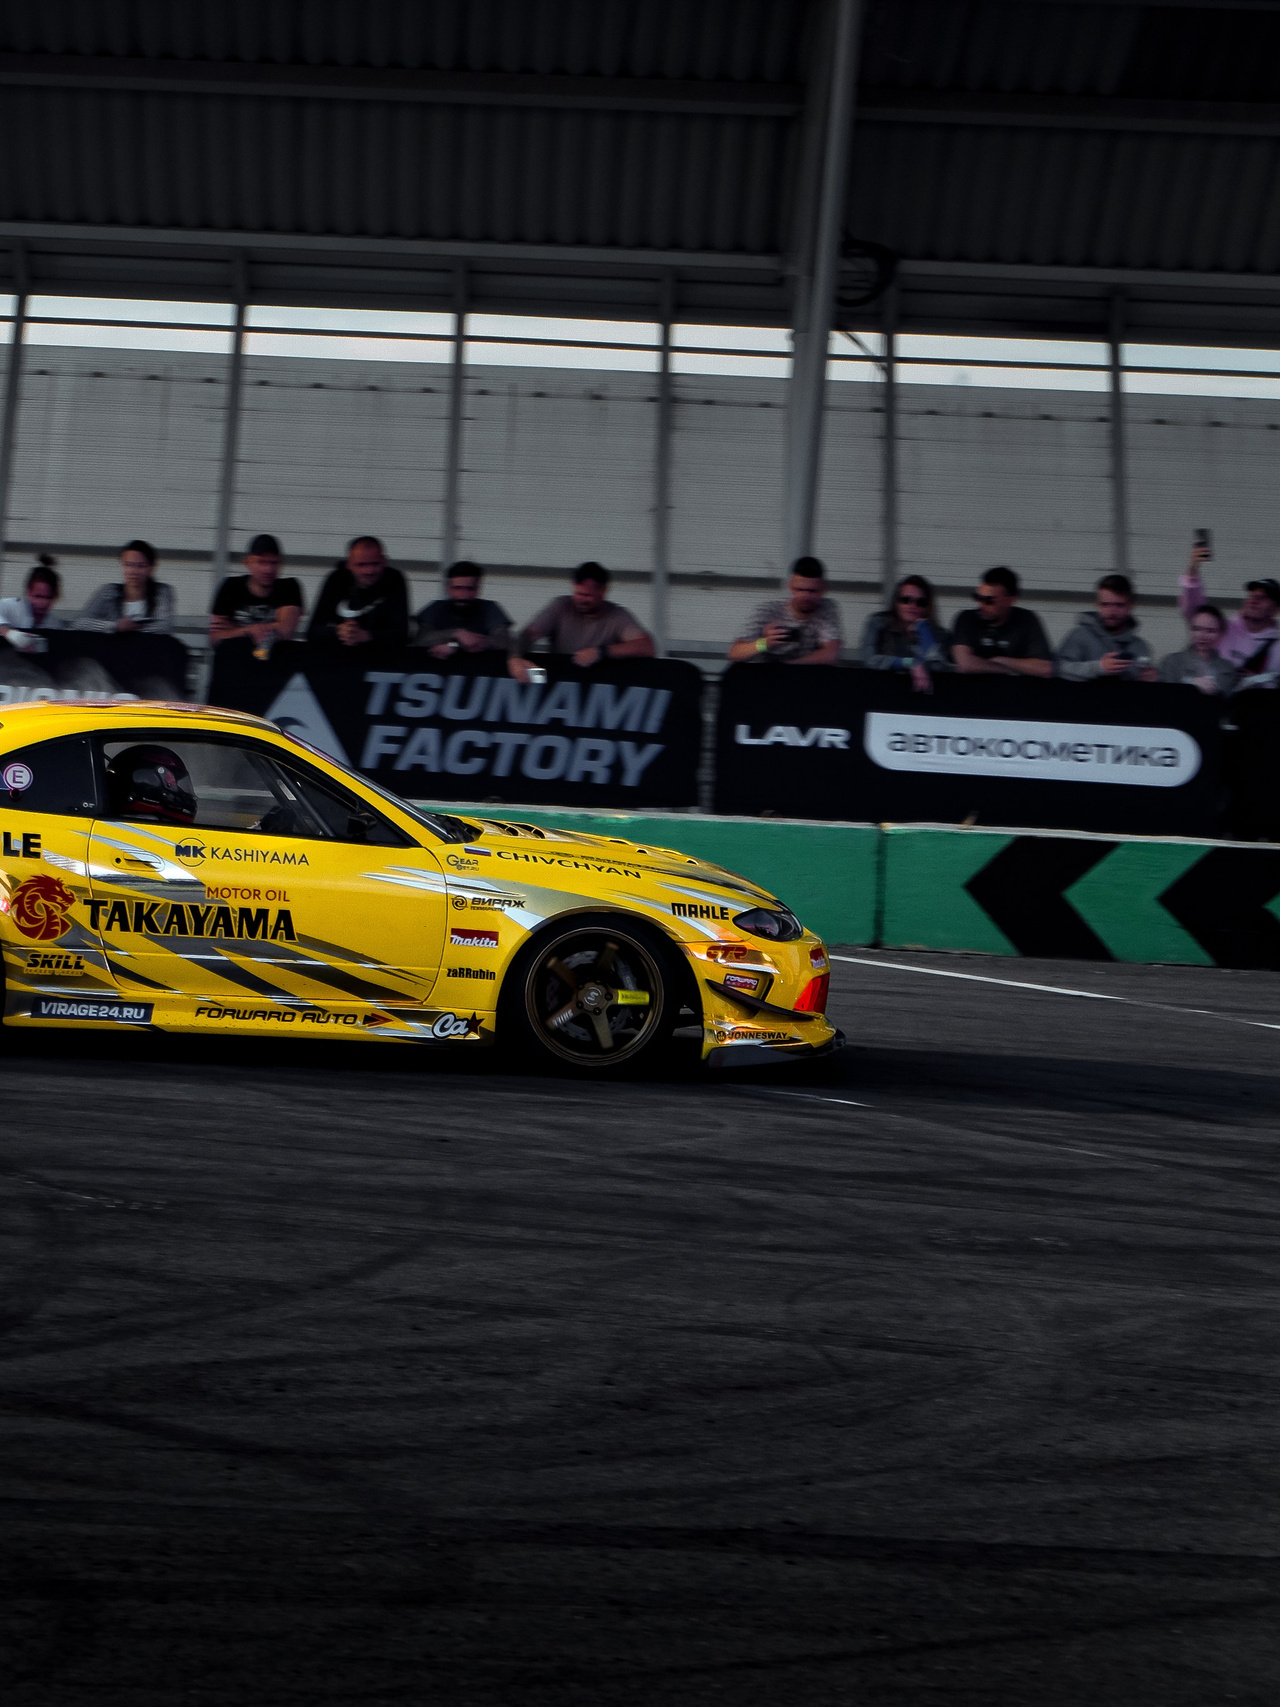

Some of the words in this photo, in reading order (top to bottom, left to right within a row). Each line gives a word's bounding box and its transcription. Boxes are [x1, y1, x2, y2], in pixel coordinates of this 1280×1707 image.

[364, 671, 672, 734] TSUNAMI
[734, 724, 851, 750] LAVR
[361, 724, 666, 787] FACTORY
[886, 730, 1182, 768] автокосметика
[12, 770, 24, 784] E
[175, 844, 207, 859] MK
[210, 847, 310, 866] KASHIYAMA
[496, 851, 642, 879] CHIVCHYAN
[206, 886, 263, 901] MOTOR
[265, 889, 291, 903] OIL
[471, 897, 526, 909] ВИРАЖ
[82, 898, 299, 942] TAKAYAMA
[671, 902, 729, 920] MAHLE
[26, 953, 85, 970] SKILL
[447, 968, 496, 981] zaRRubin
[40, 1001, 146, 1020] VIRAGE24.RU
[195, 1007, 297, 1023] FORWARD
[300, 1013, 359, 1026] AUTO
[727, 1030, 789, 1040] JONNESWAY
